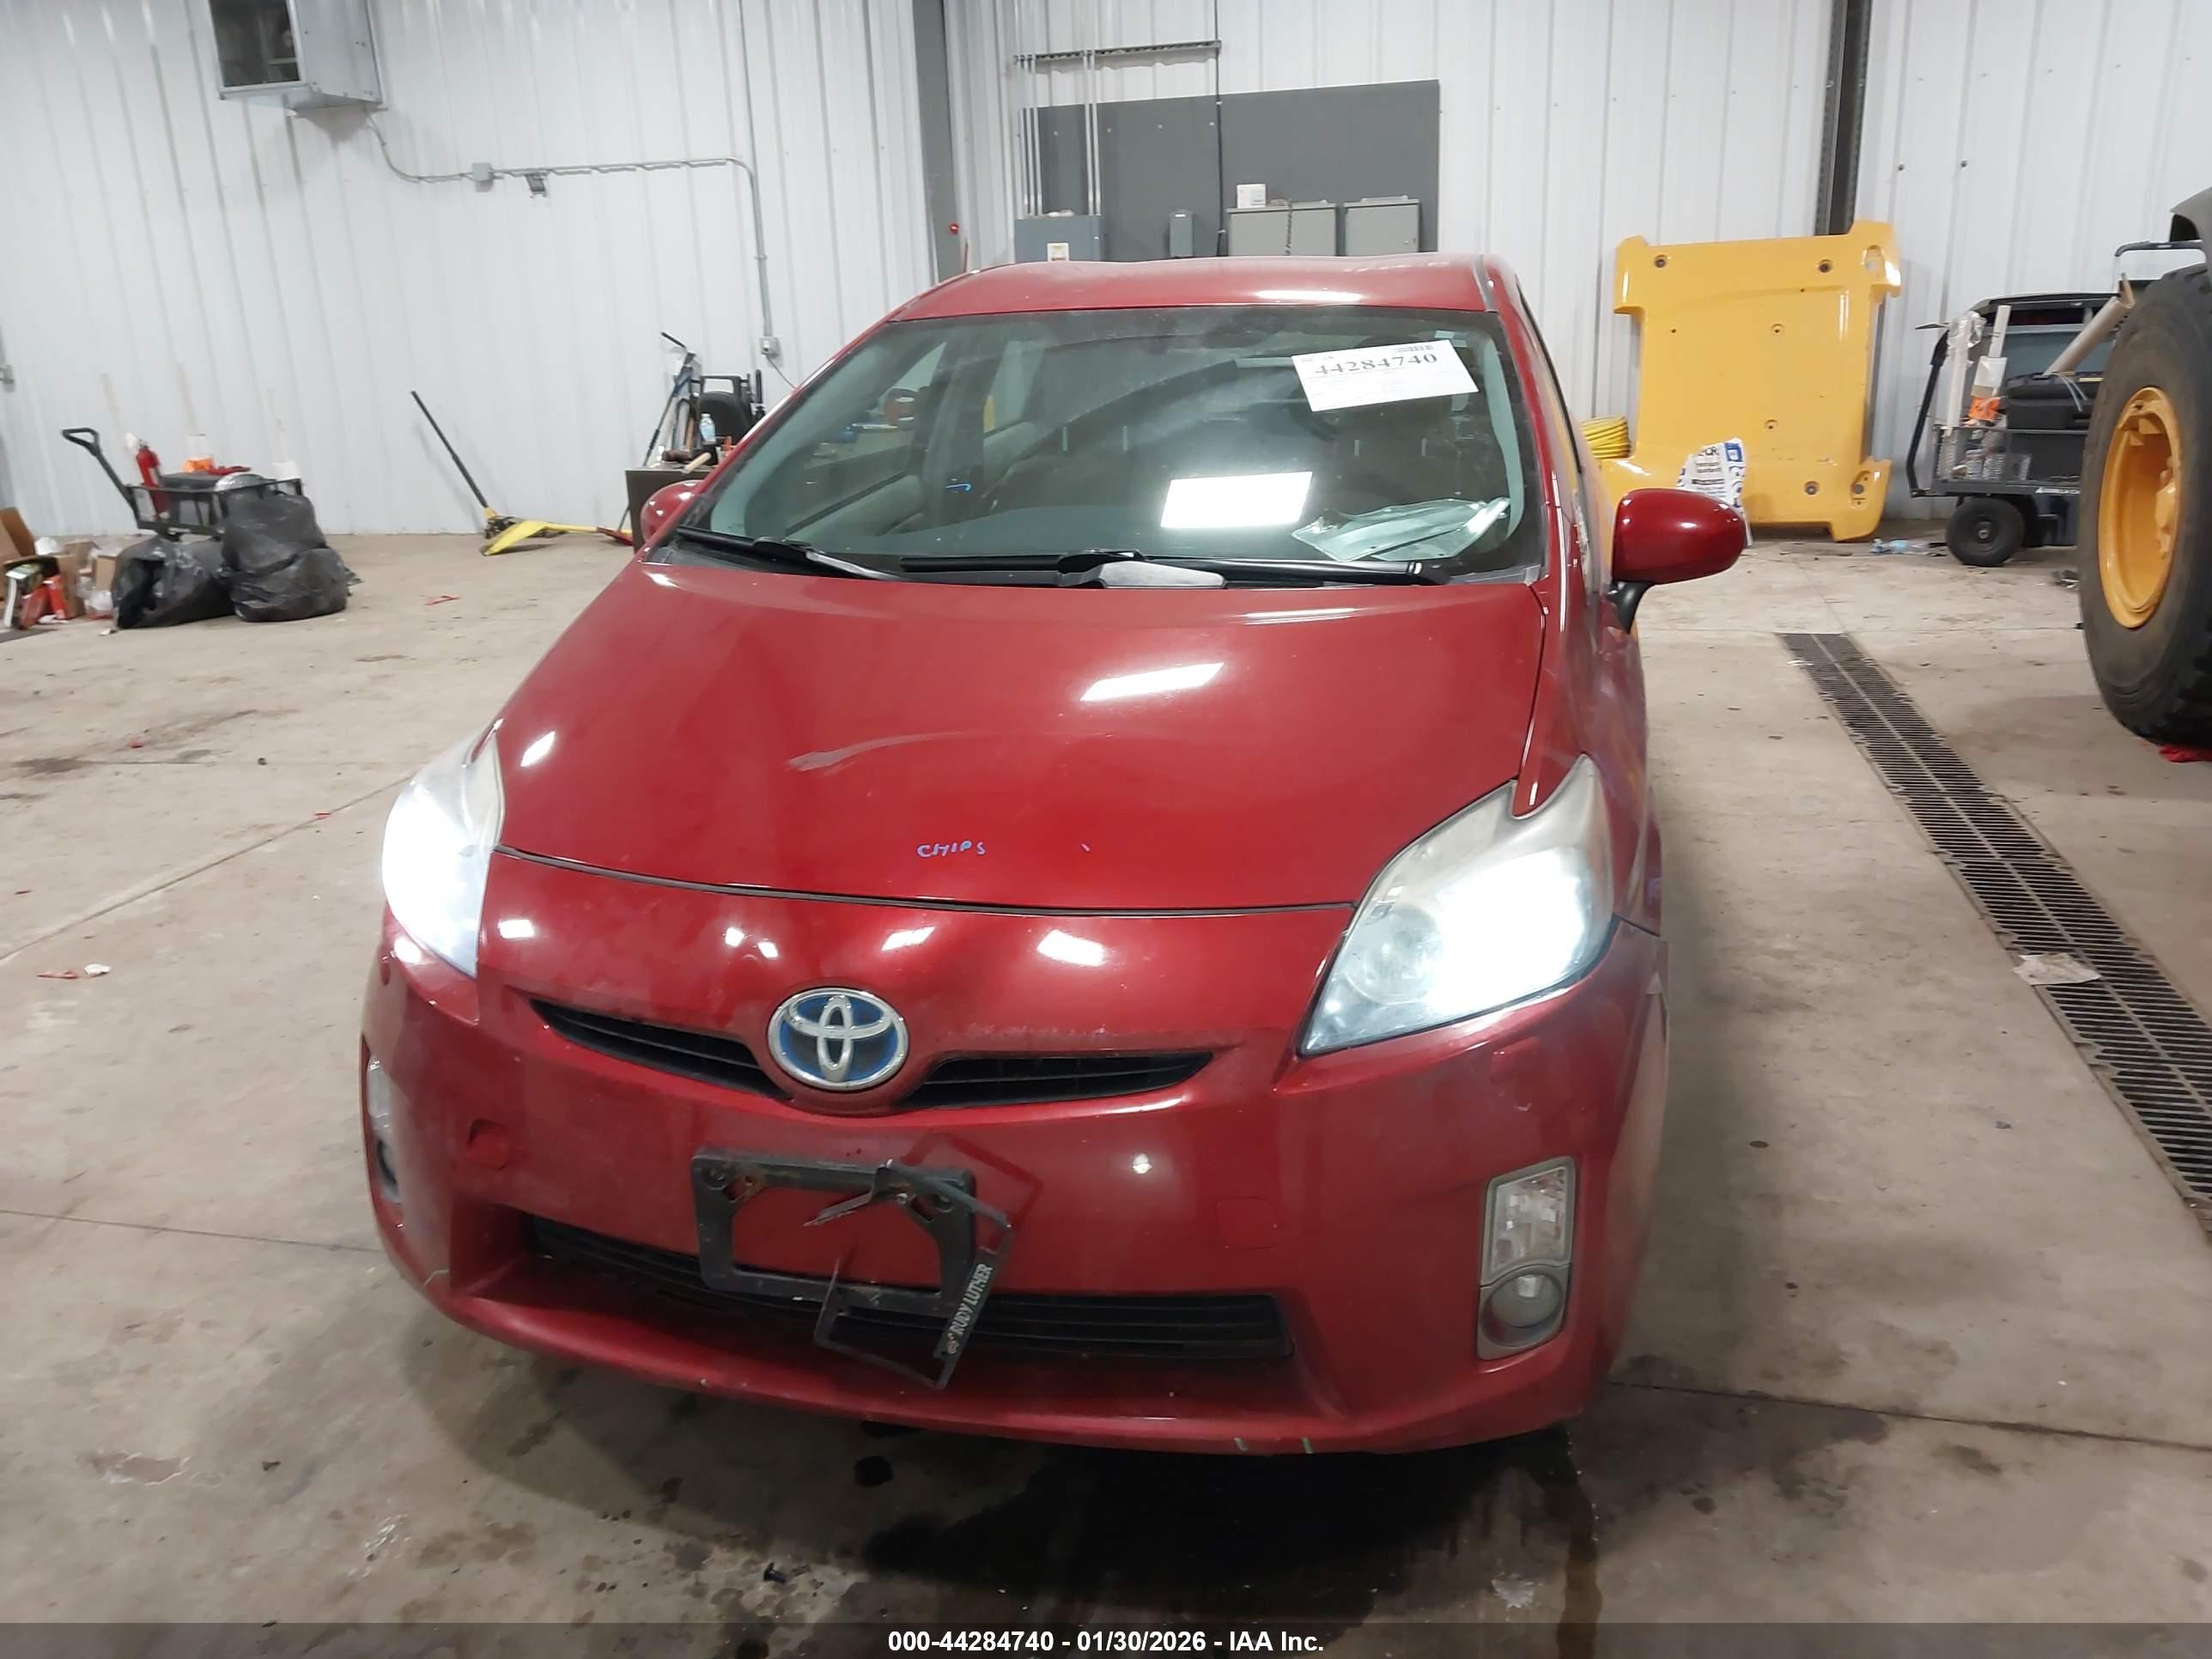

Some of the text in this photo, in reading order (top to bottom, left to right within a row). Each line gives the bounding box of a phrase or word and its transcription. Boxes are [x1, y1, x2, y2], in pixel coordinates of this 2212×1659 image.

[1316, 353, 1437, 374] 44284740
[916, 840, 987, 858] CHIPS
[948, 1263, 994, 1335] RUDY LUTHER
